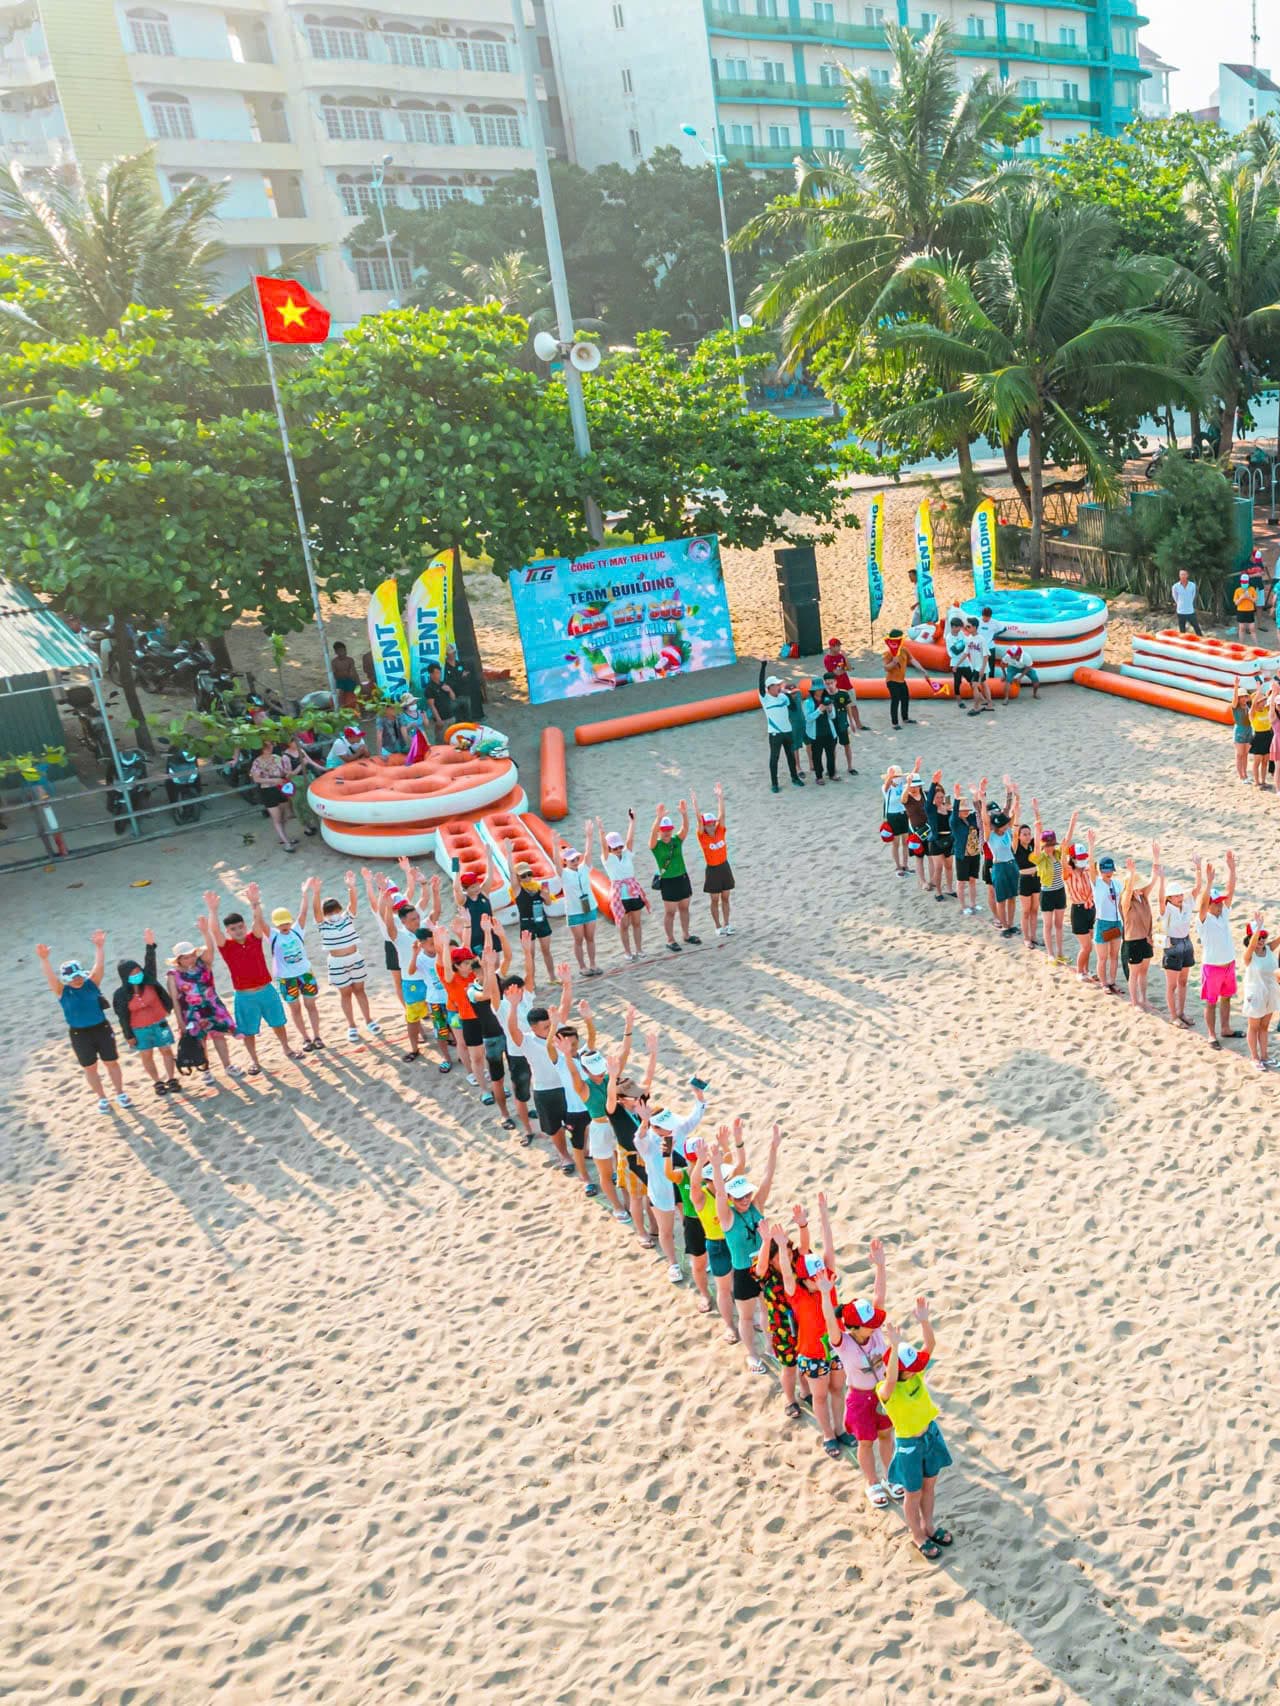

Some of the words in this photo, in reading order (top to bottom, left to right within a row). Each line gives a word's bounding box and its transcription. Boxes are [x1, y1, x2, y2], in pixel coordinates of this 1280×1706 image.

[525, 565, 556, 583] TLG
[917, 533, 935, 599] EVENT
[568, 588, 608, 605] TEAM
[612, 577, 675, 597] BUILDING
